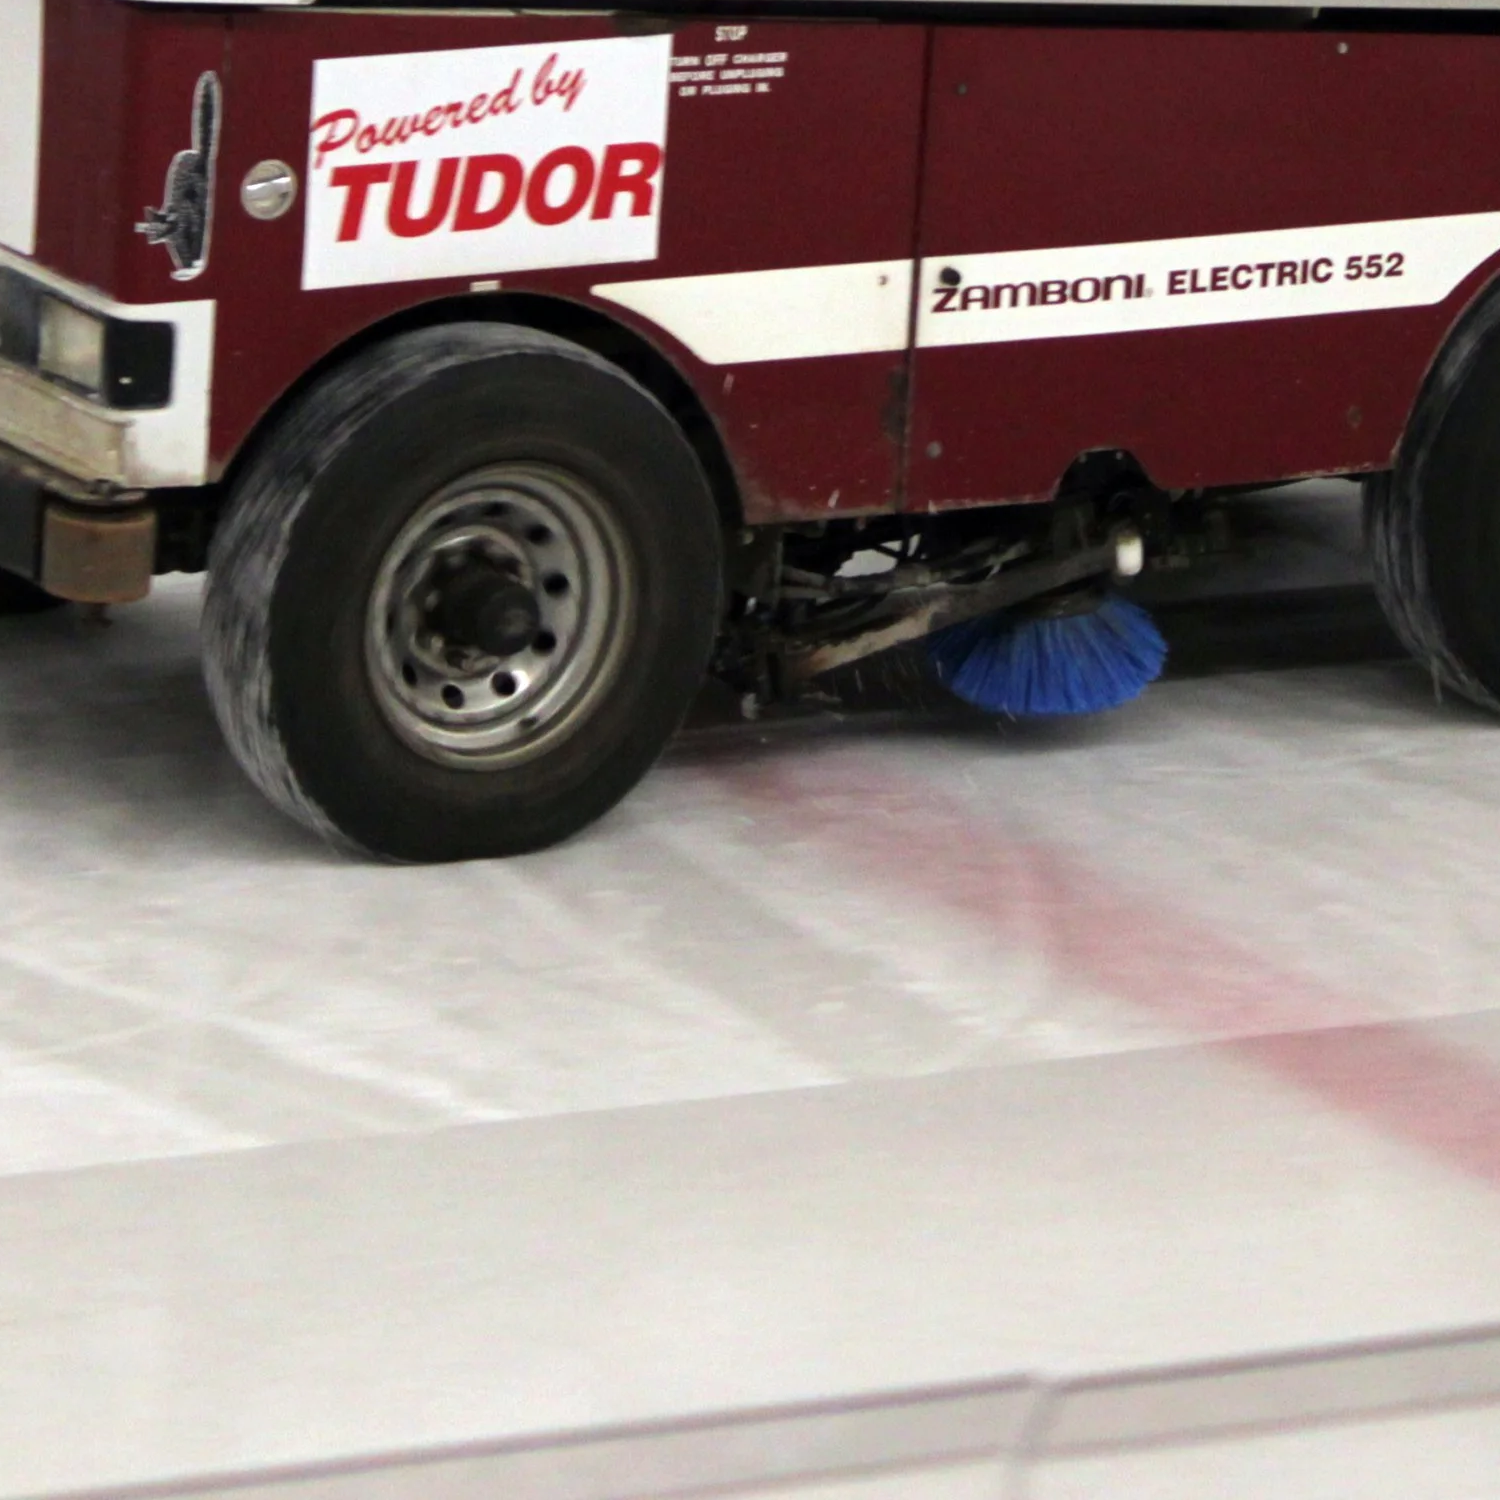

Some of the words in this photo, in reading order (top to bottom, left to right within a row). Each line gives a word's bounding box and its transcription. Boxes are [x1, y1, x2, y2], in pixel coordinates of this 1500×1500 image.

[714, 25, 749, 42] STOP
[311, 68, 522, 169] Powered
[530, 52, 587, 112] by
[328, 141, 662, 242] TUDOR
[930, 272, 1146, 314] ZAMBONI
[1167, 257, 1334, 297] ELECTRIC
[1343, 251, 1405, 280] 552
